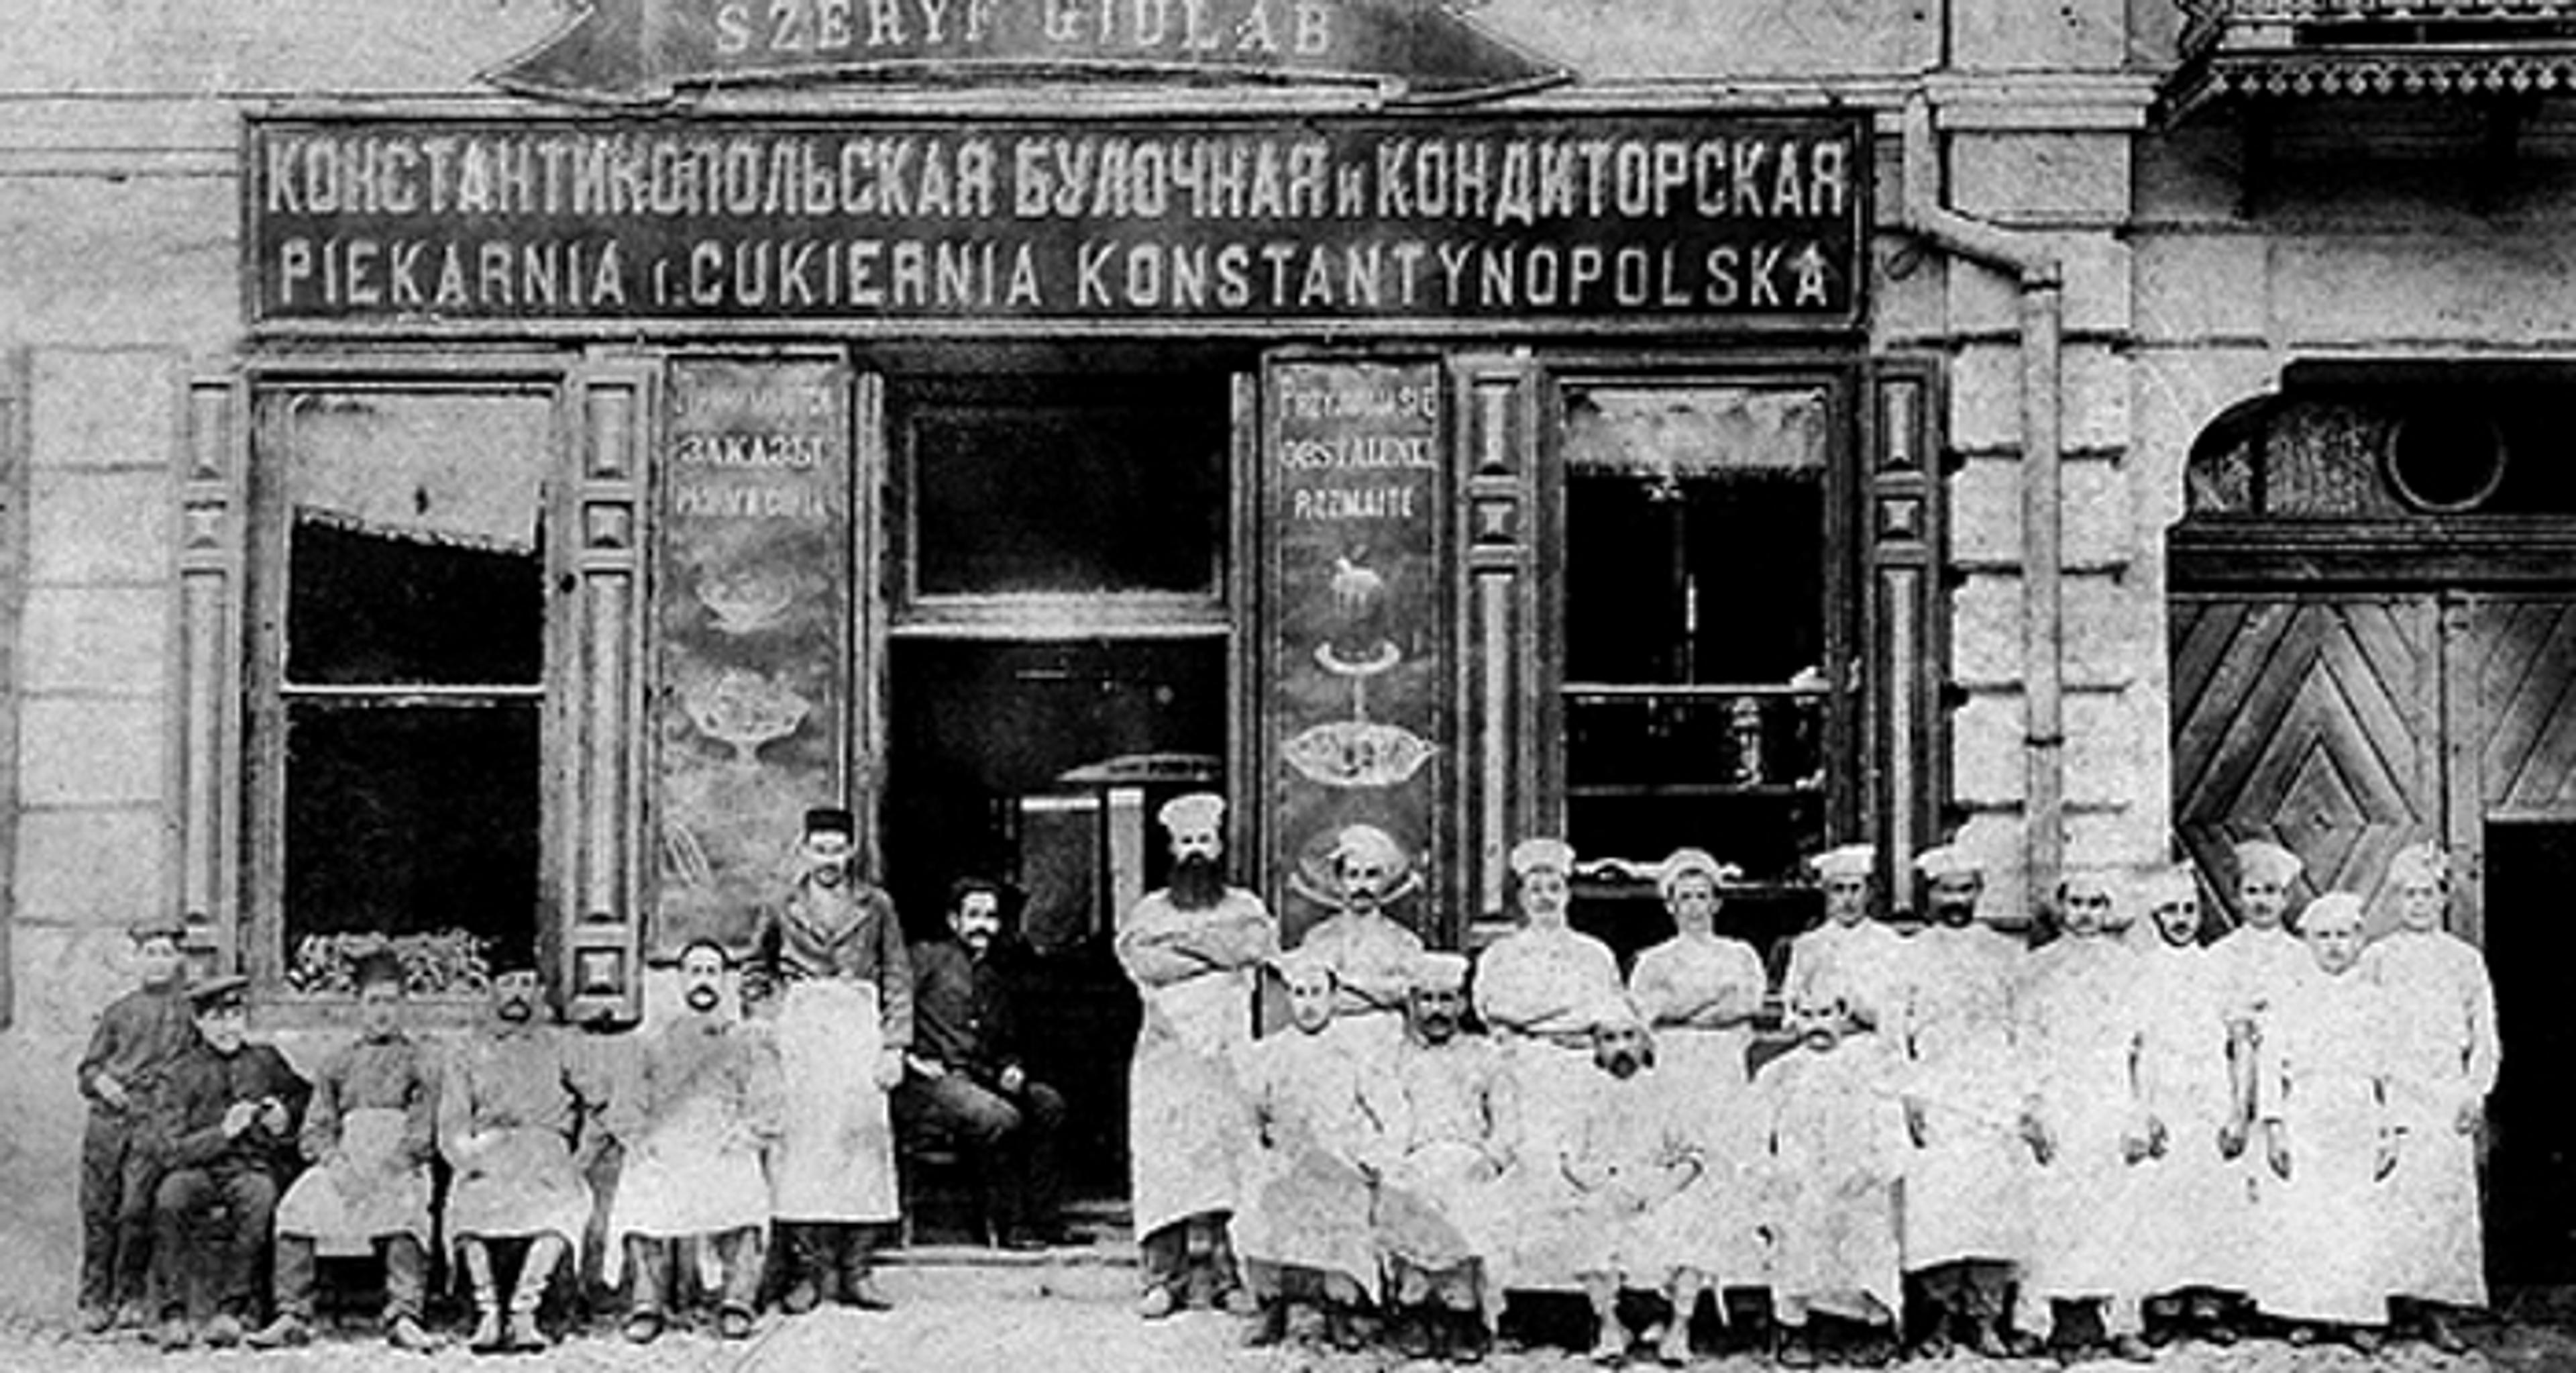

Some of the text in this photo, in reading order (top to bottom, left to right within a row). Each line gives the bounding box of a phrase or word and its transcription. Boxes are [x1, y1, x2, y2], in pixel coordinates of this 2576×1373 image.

[716, 0, 994, 54] SZERYF
[1014, 137, 1328, 217] БУЛОЧНАЯ
[1377, 137, 1846, 226] КОНДИТОРСКАЯ
[280, 238, 625, 306] PIEKARNIA
[690, 238, 1042, 307] CUKIERNIA
[1077, 240, 1827, 307] KONSTANTYNOPOLSKA
[679, 436, 823, 468] ЗАКАЗЫ
